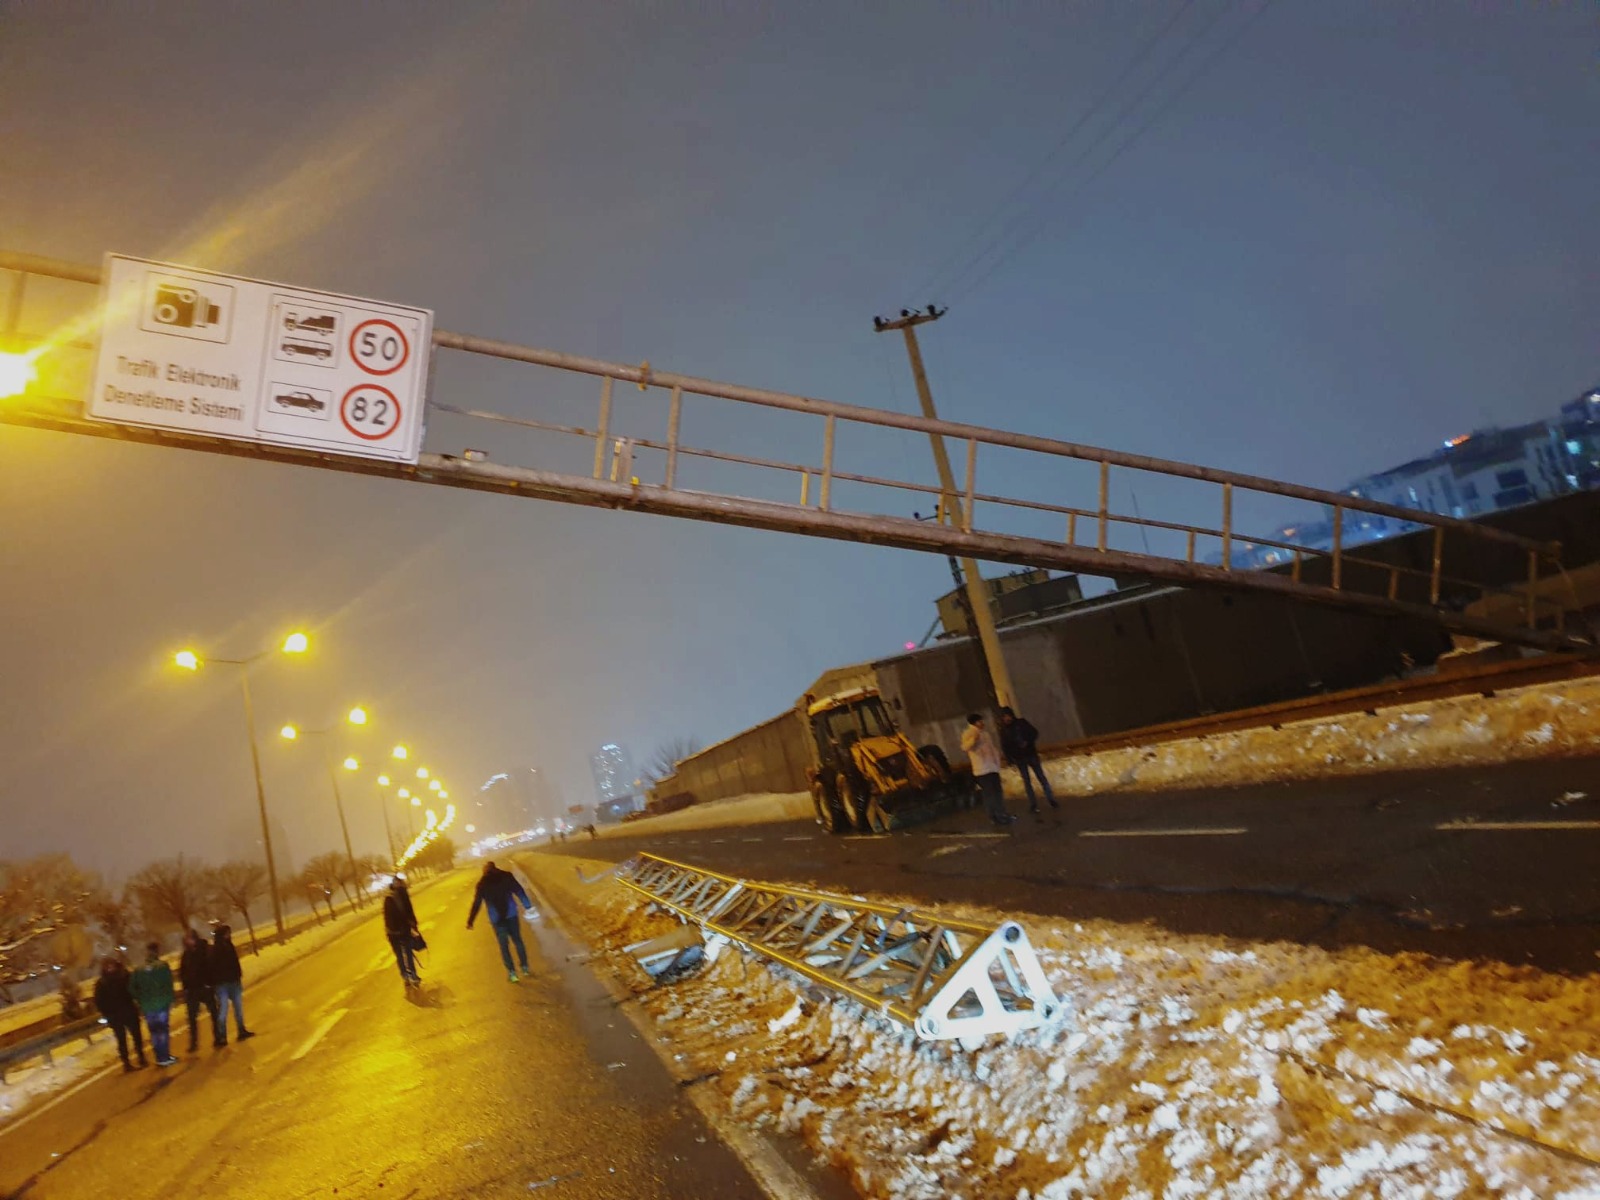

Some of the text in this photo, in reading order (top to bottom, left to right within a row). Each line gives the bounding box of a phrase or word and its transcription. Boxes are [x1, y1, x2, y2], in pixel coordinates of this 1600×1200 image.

[359, 332, 399, 361] 50
[117, 355, 241, 391] Trafik Elektronik
[188, 396, 245, 421] Sistemi
[350, 396, 387, 426] 82
